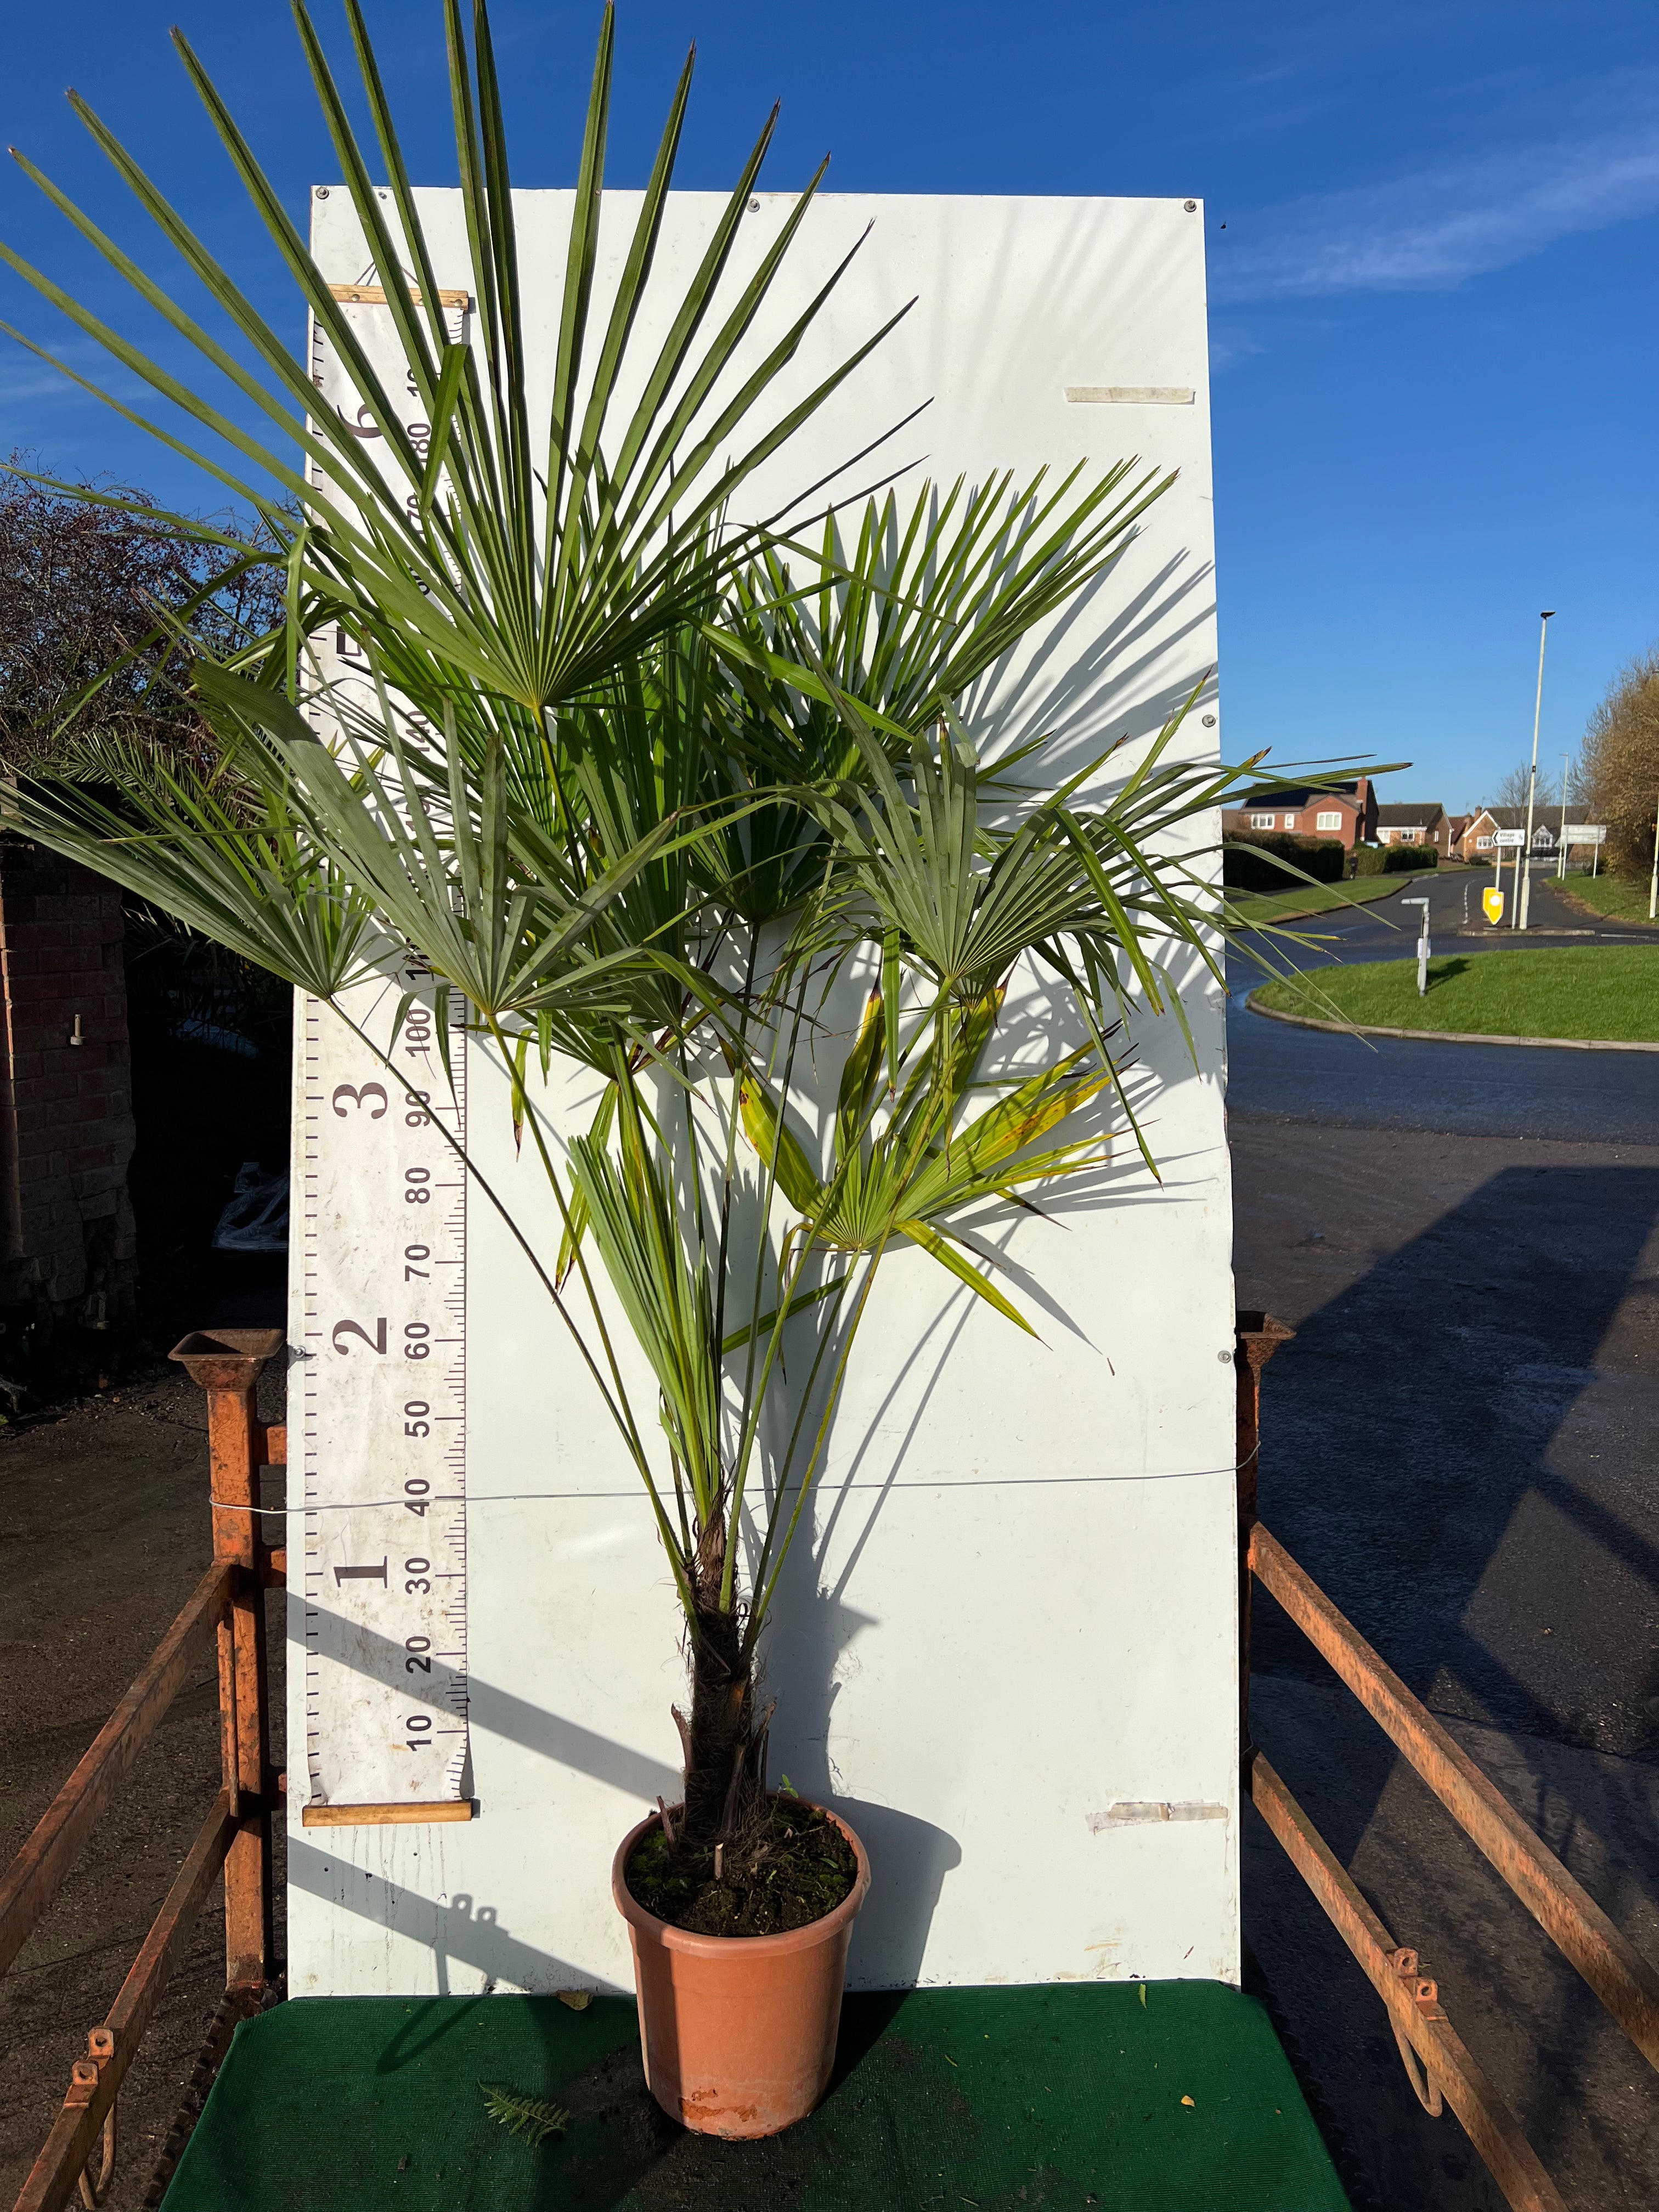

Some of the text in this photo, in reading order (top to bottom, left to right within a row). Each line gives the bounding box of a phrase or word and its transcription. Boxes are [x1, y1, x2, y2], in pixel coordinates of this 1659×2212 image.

[405, 1008, 431, 1057] 100
[332, 1082, 388, 1119] 3
[405, 1090, 431, 1127] 90
[405, 1167, 430, 1204] 80
[405, 1244, 430, 1282] 70
[332, 1317, 387, 1356] 2
[404, 1322, 430, 1359] 60
[404, 1401, 430, 1438] 50
[404, 1479, 430, 1516] 40
[334, 1555, 387, 1589] 1
[405, 1557, 430, 1594] 30
[405, 1636, 431, 1674] 20
[406, 1715, 432, 1752] 10
